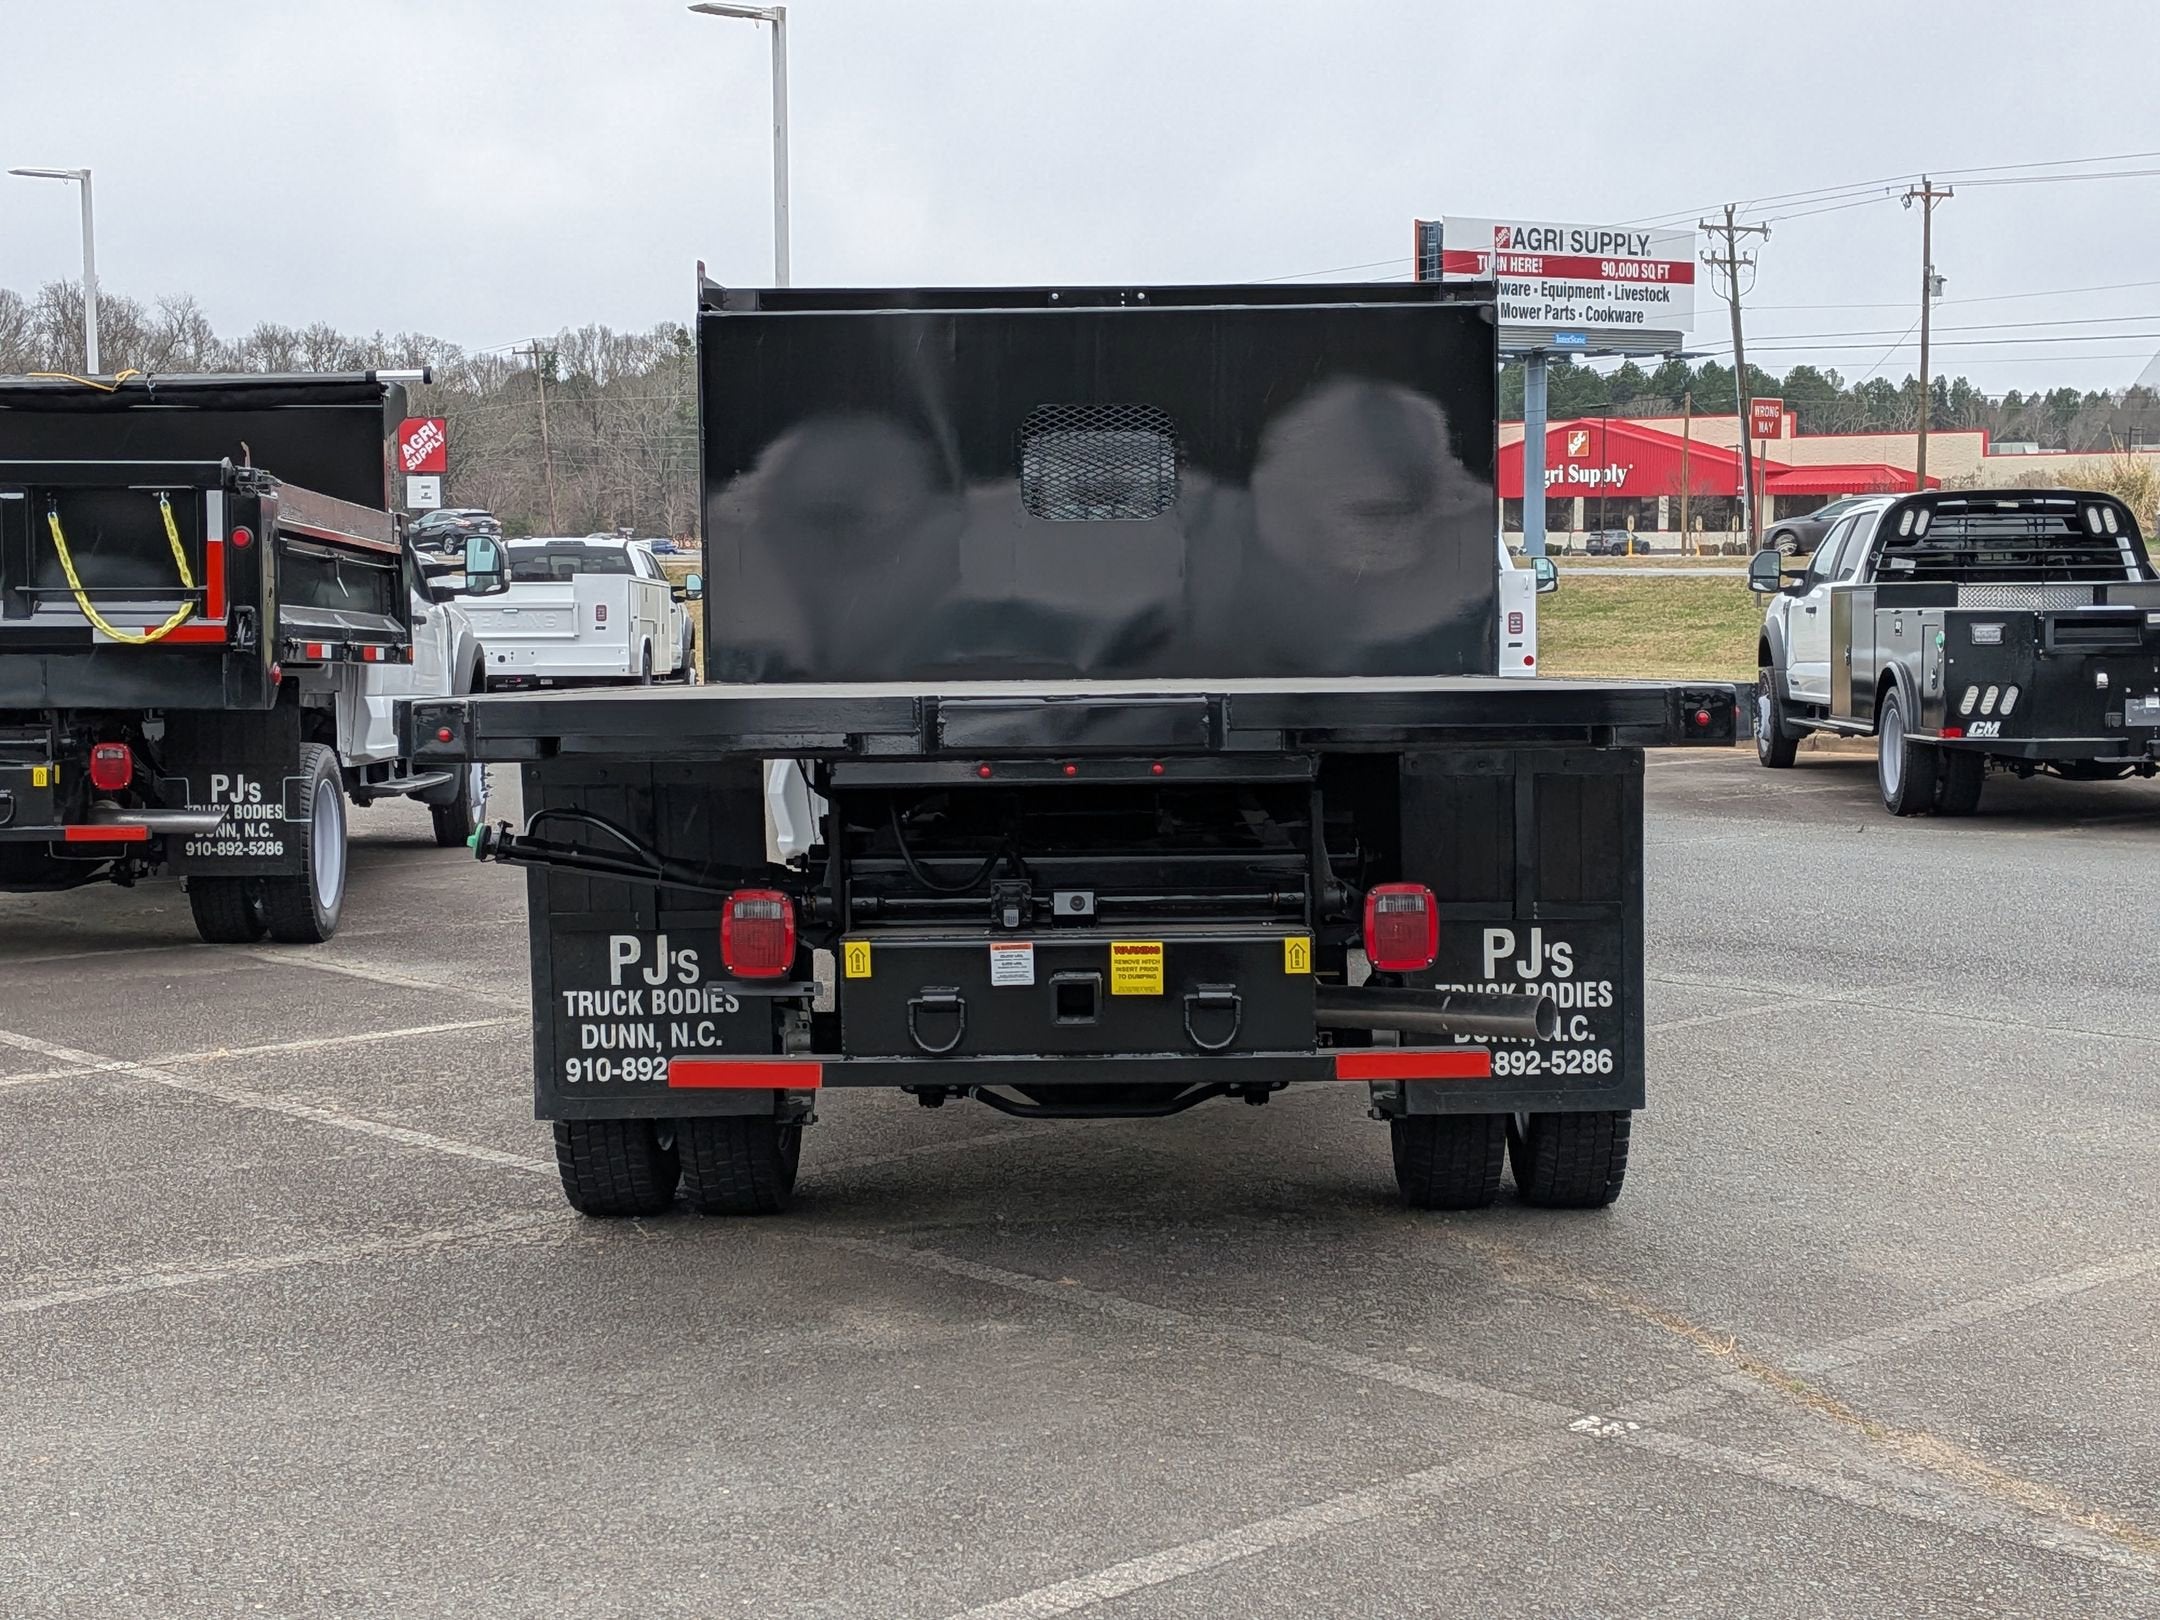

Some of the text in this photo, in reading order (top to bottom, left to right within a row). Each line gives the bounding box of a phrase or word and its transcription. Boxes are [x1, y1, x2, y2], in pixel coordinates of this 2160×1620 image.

[1512, 227, 1563, 252] AGRI
[1570, 230, 1650, 256] SUPPLY
[1477, 255, 1543, 273] TUN HERE!
[1601, 261, 1670, 280] 90,000 SQ FT
[1541, 281, 1605, 302] Equipment
[1615, 284, 1670, 302] Livestock
[1500, 302, 1644, 323] Mower Parts Cookware
[1754, 405, 1779, 418] WRONG
[1758, 421, 1774, 434] WAY
[402, 420, 438, 459] AGRI
[406, 430, 444, 470] SUPPLY
[1568, 464, 1628, 488] Supply
[1967, 721, 2001, 737] CM
[211, 774, 262, 803] PJ's
[234, 804, 283, 819] BODIES
[245, 823, 274, 837] N.C.
[185, 841, 284, 856] 910-892-5286
[609, 934, 700, 986] PJ's
[1483, 927, 1574, 979] PJ's
[562, 988, 740, 1017] TRUCK BODIES
[581, 1021, 723, 1053] DUNN, N.C.
